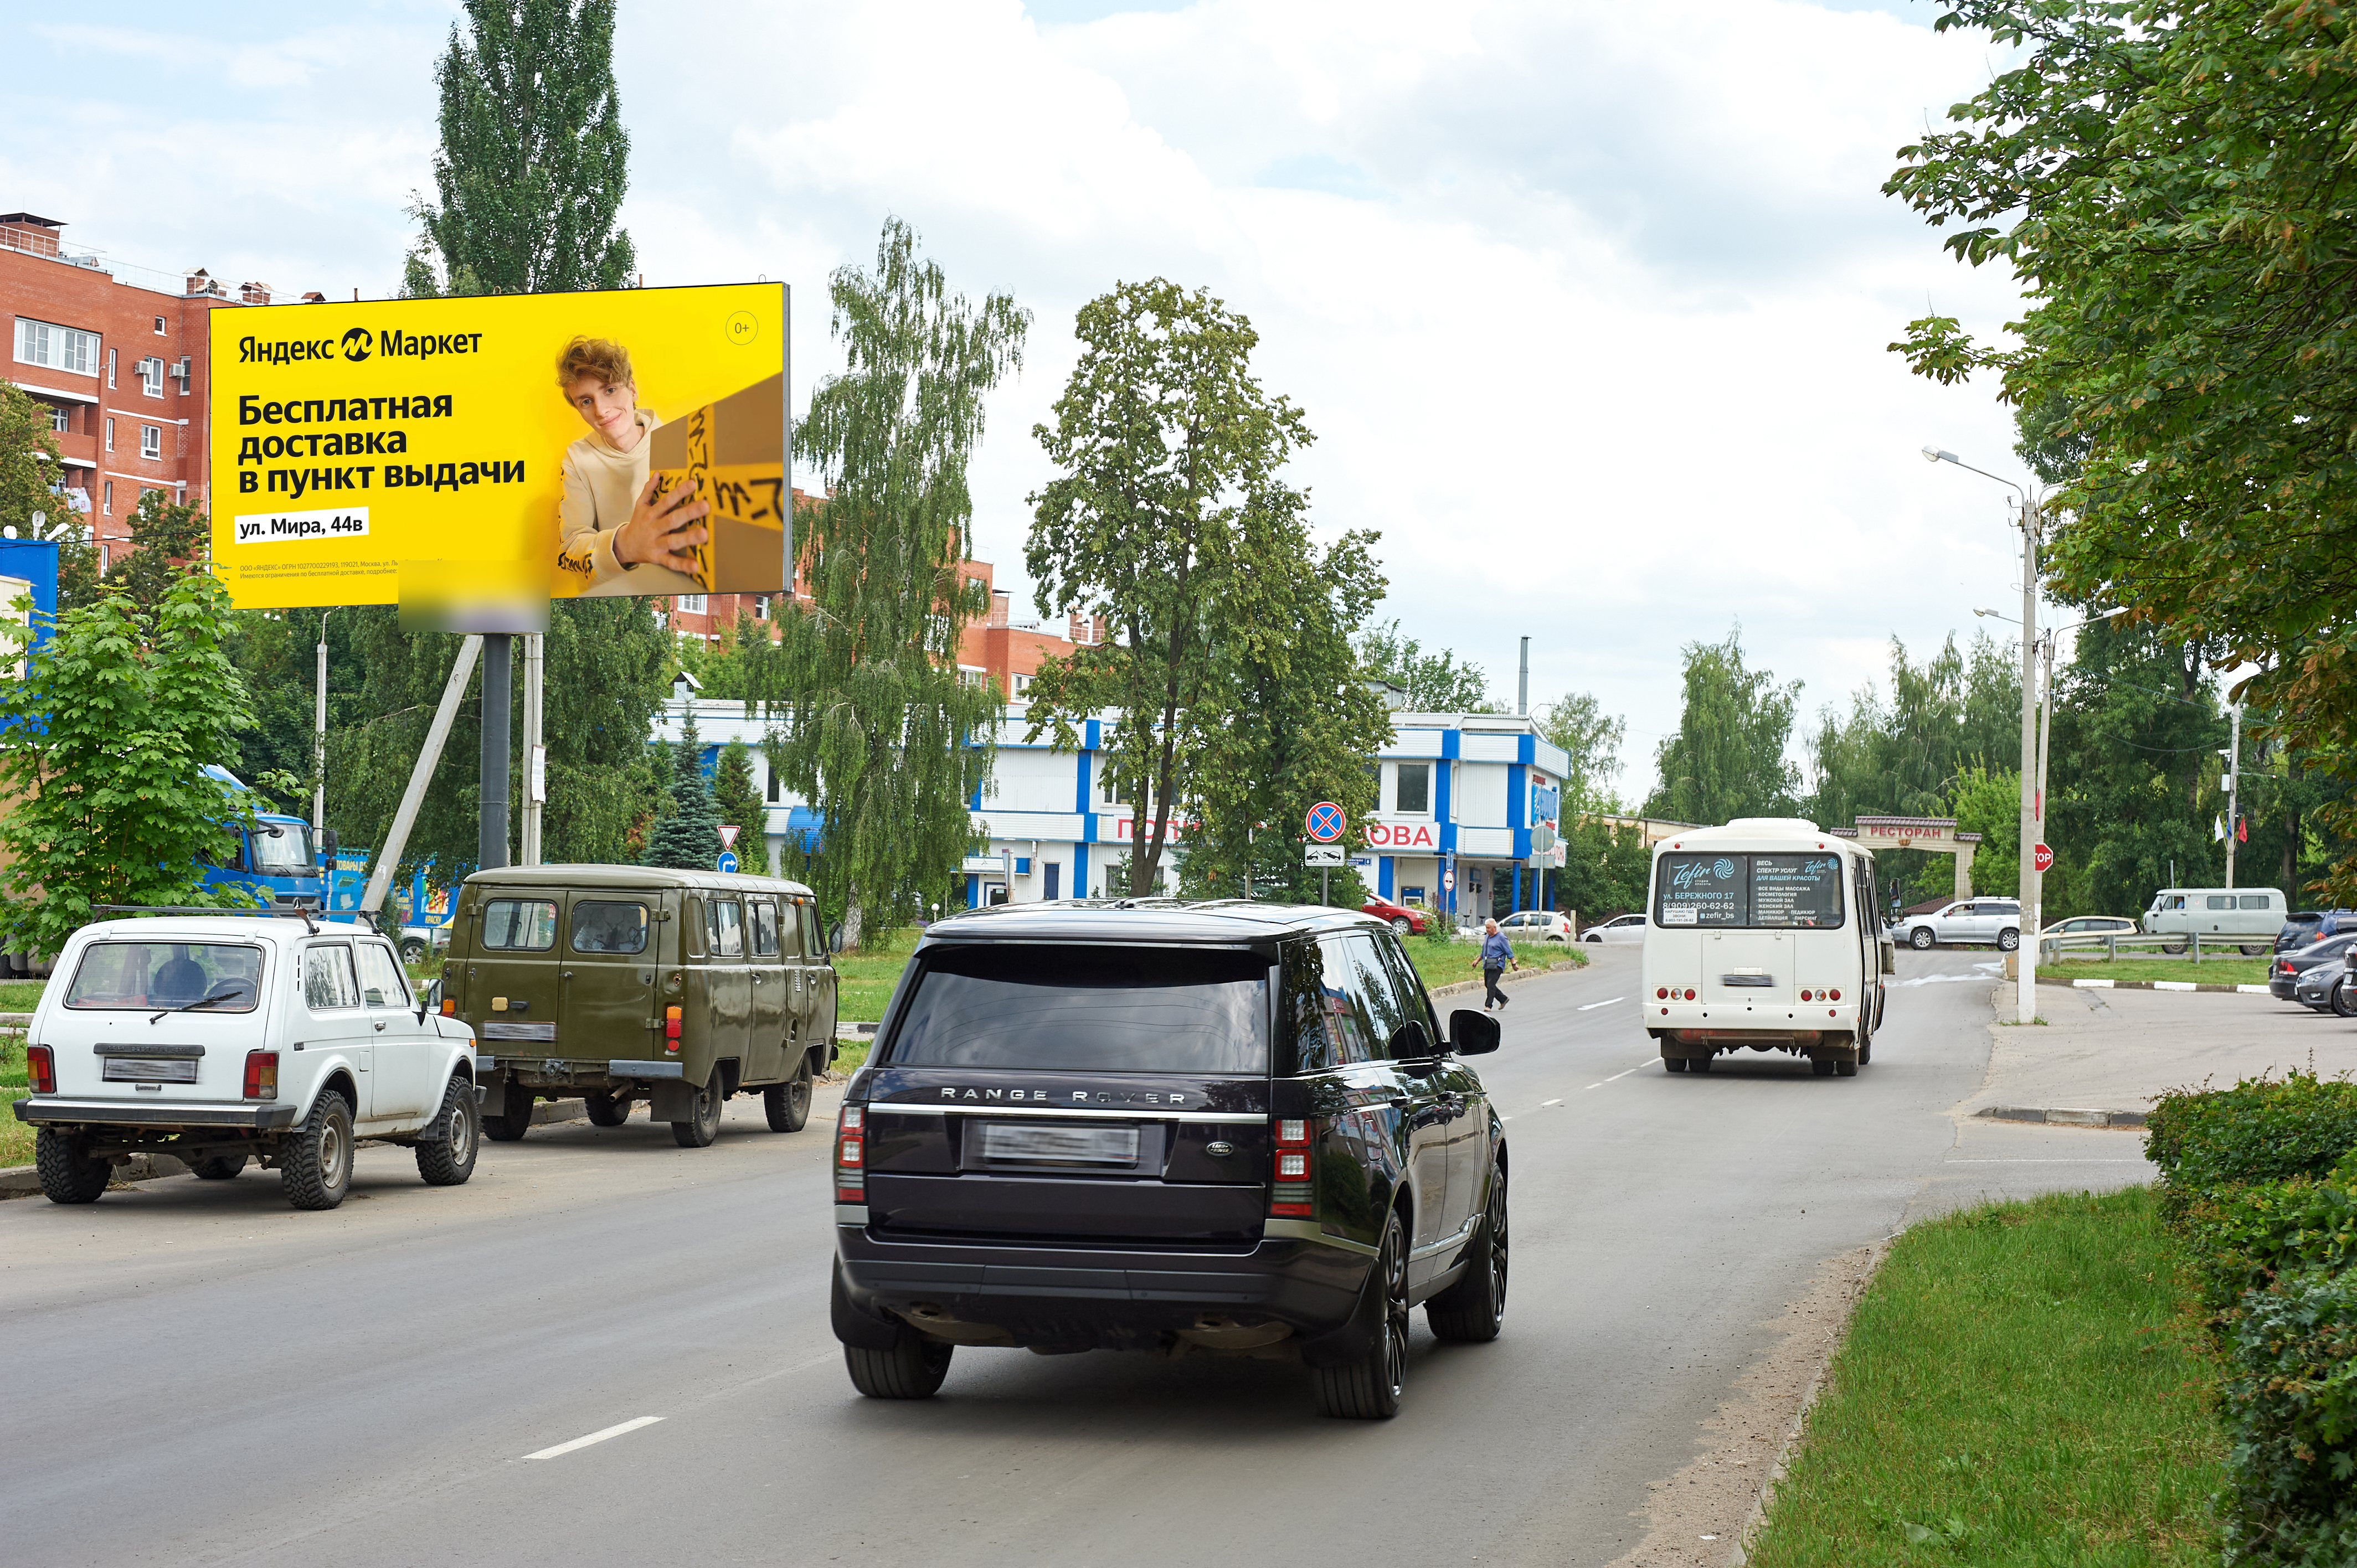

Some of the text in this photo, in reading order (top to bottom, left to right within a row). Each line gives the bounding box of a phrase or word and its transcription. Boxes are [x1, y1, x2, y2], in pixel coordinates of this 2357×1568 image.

[734, 322, 749, 334] 0+
[239, 330, 483, 365] Яндекс Маркет
[239, 395, 452, 425] Бесплатная
[238, 431, 407, 466] доставка
[239, 461, 526, 499] в пункт выдачи
[240, 515, 363, 539] ул. Мира, 44в
[1870, 826, 1941, 838] РЕСТОРАН
[1672, 862, 1712, 889] Zefir
[1706, 912, 1735, 920] zefir_bs
[941, 1087, 1186, 1104] RANGE ROVER
